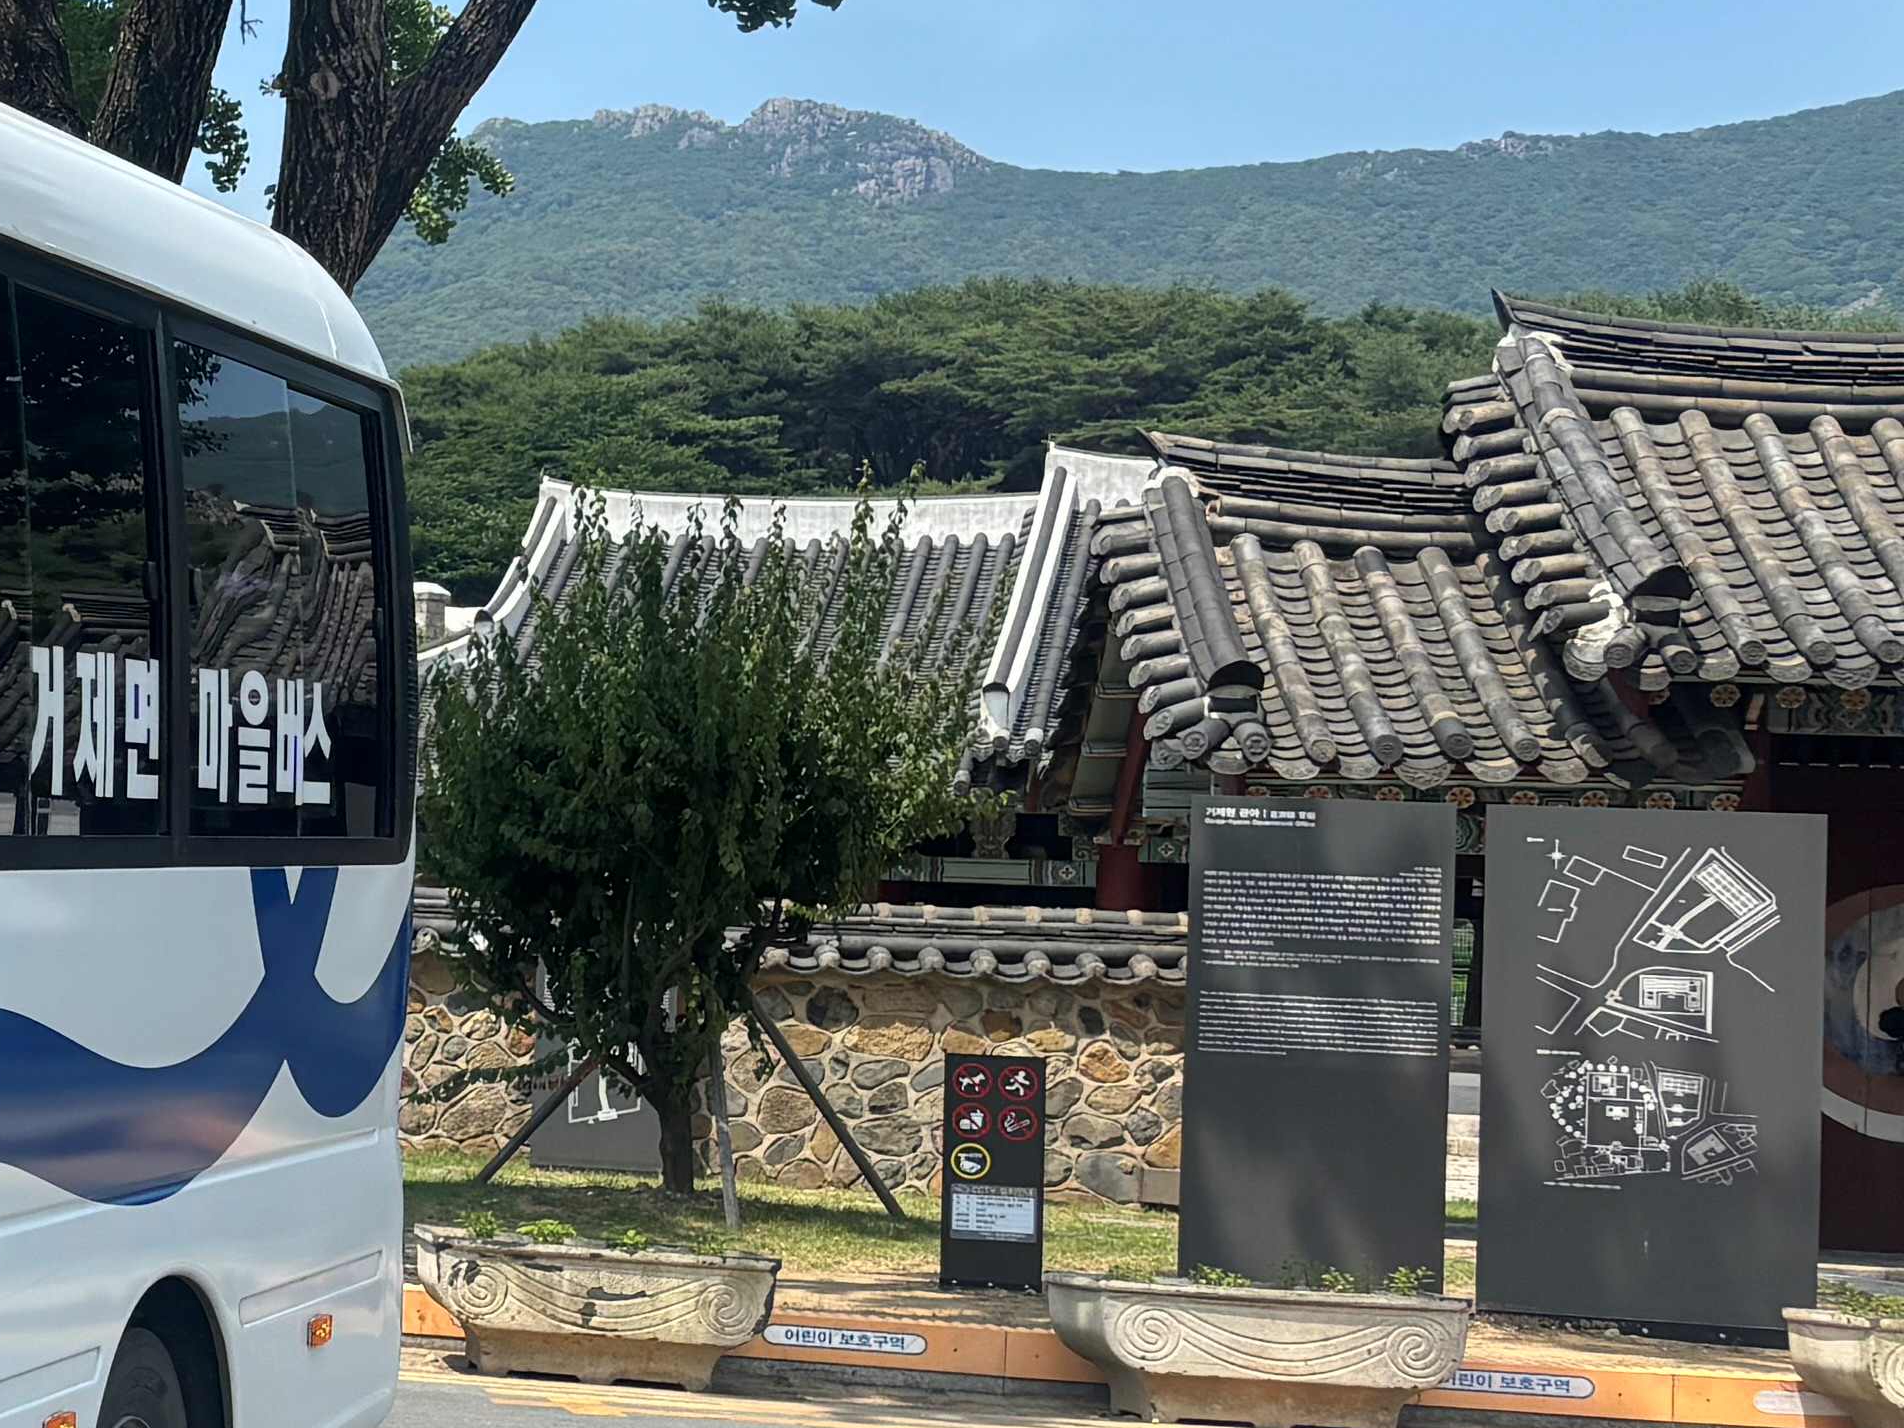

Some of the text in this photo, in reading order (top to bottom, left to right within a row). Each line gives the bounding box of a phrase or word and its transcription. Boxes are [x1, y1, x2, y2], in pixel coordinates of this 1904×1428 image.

[28, 645, 332, 806] 거제면 마을버스
[839, 1333, 905, 1350] 보호구역
[1500, 1376, 1570, 1394] 보호구역
